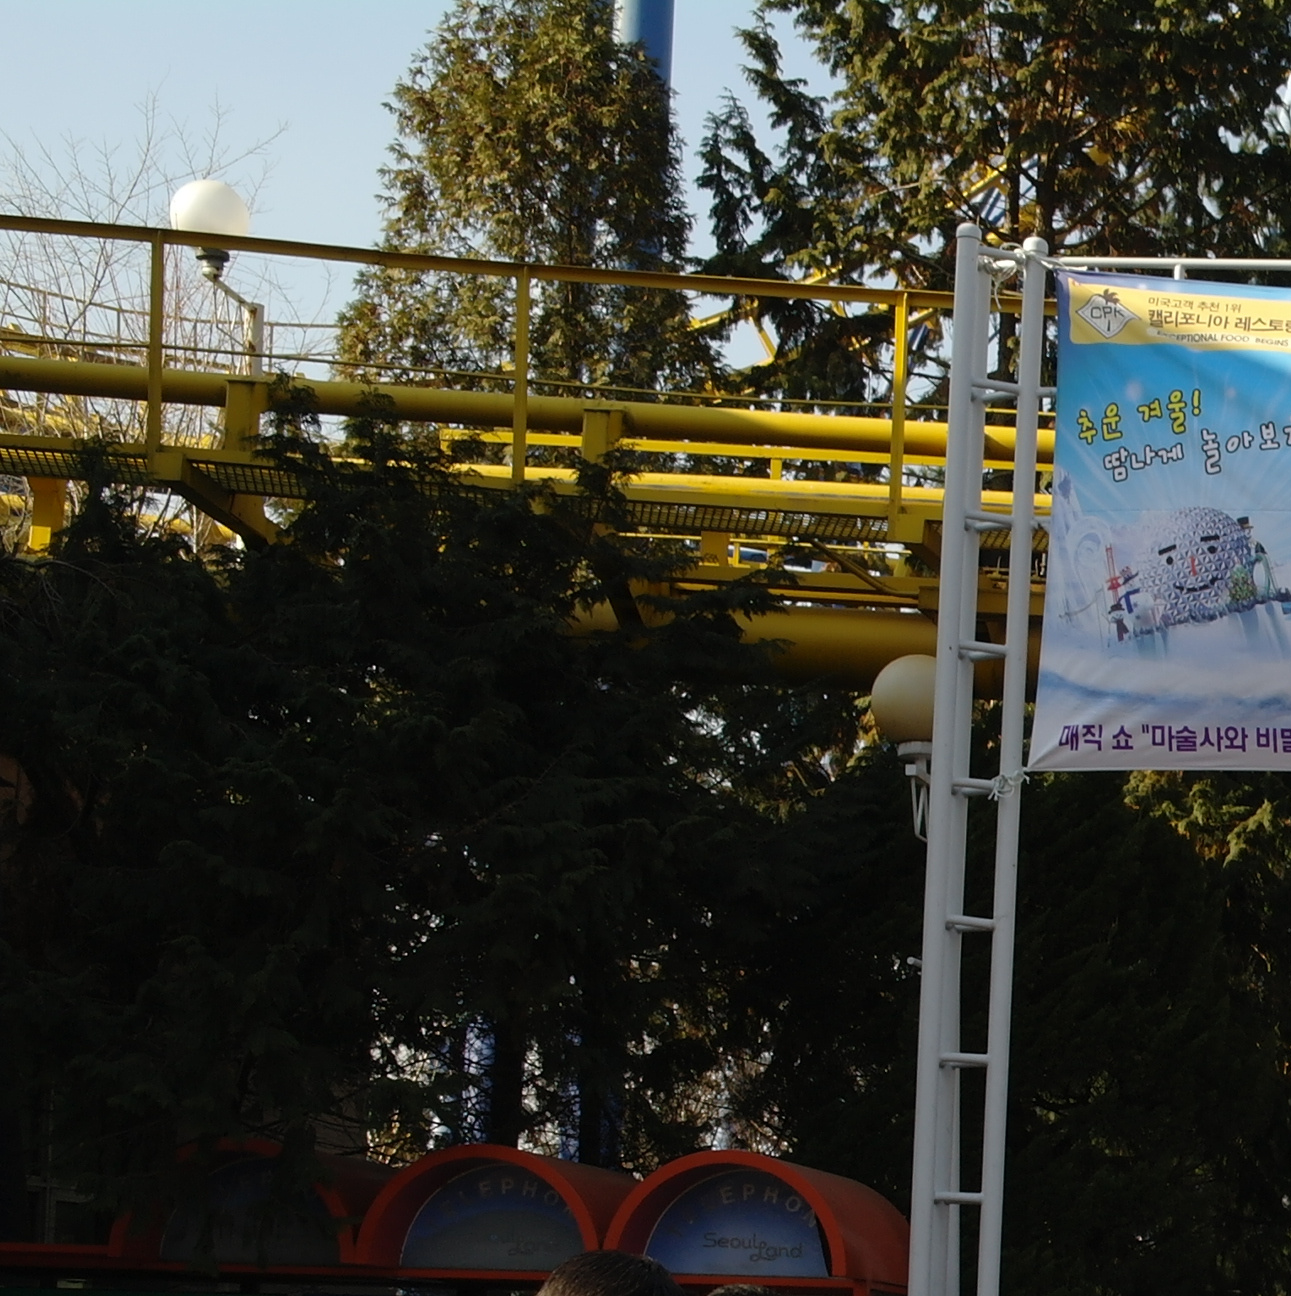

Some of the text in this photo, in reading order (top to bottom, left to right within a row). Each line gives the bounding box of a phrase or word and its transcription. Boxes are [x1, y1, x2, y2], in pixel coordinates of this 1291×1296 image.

[1148, 297, 1242, 314] 미국고객 추천 1위
[1148, 309, 1230, 330] 캘리포니아
[1220, 334, 1250, 343] FOOD
[1255, 337, 1289, 347] BEGINS
[1077, 389, 1201, 444] 추운 겨울!
[1104, 443, 1184, 482] 땀나게
[1058, 724, 1103, 751] 매직
[1111, 726, 1134, 750] 쇼
[1142, 724, 1249, 752] "마술사와
